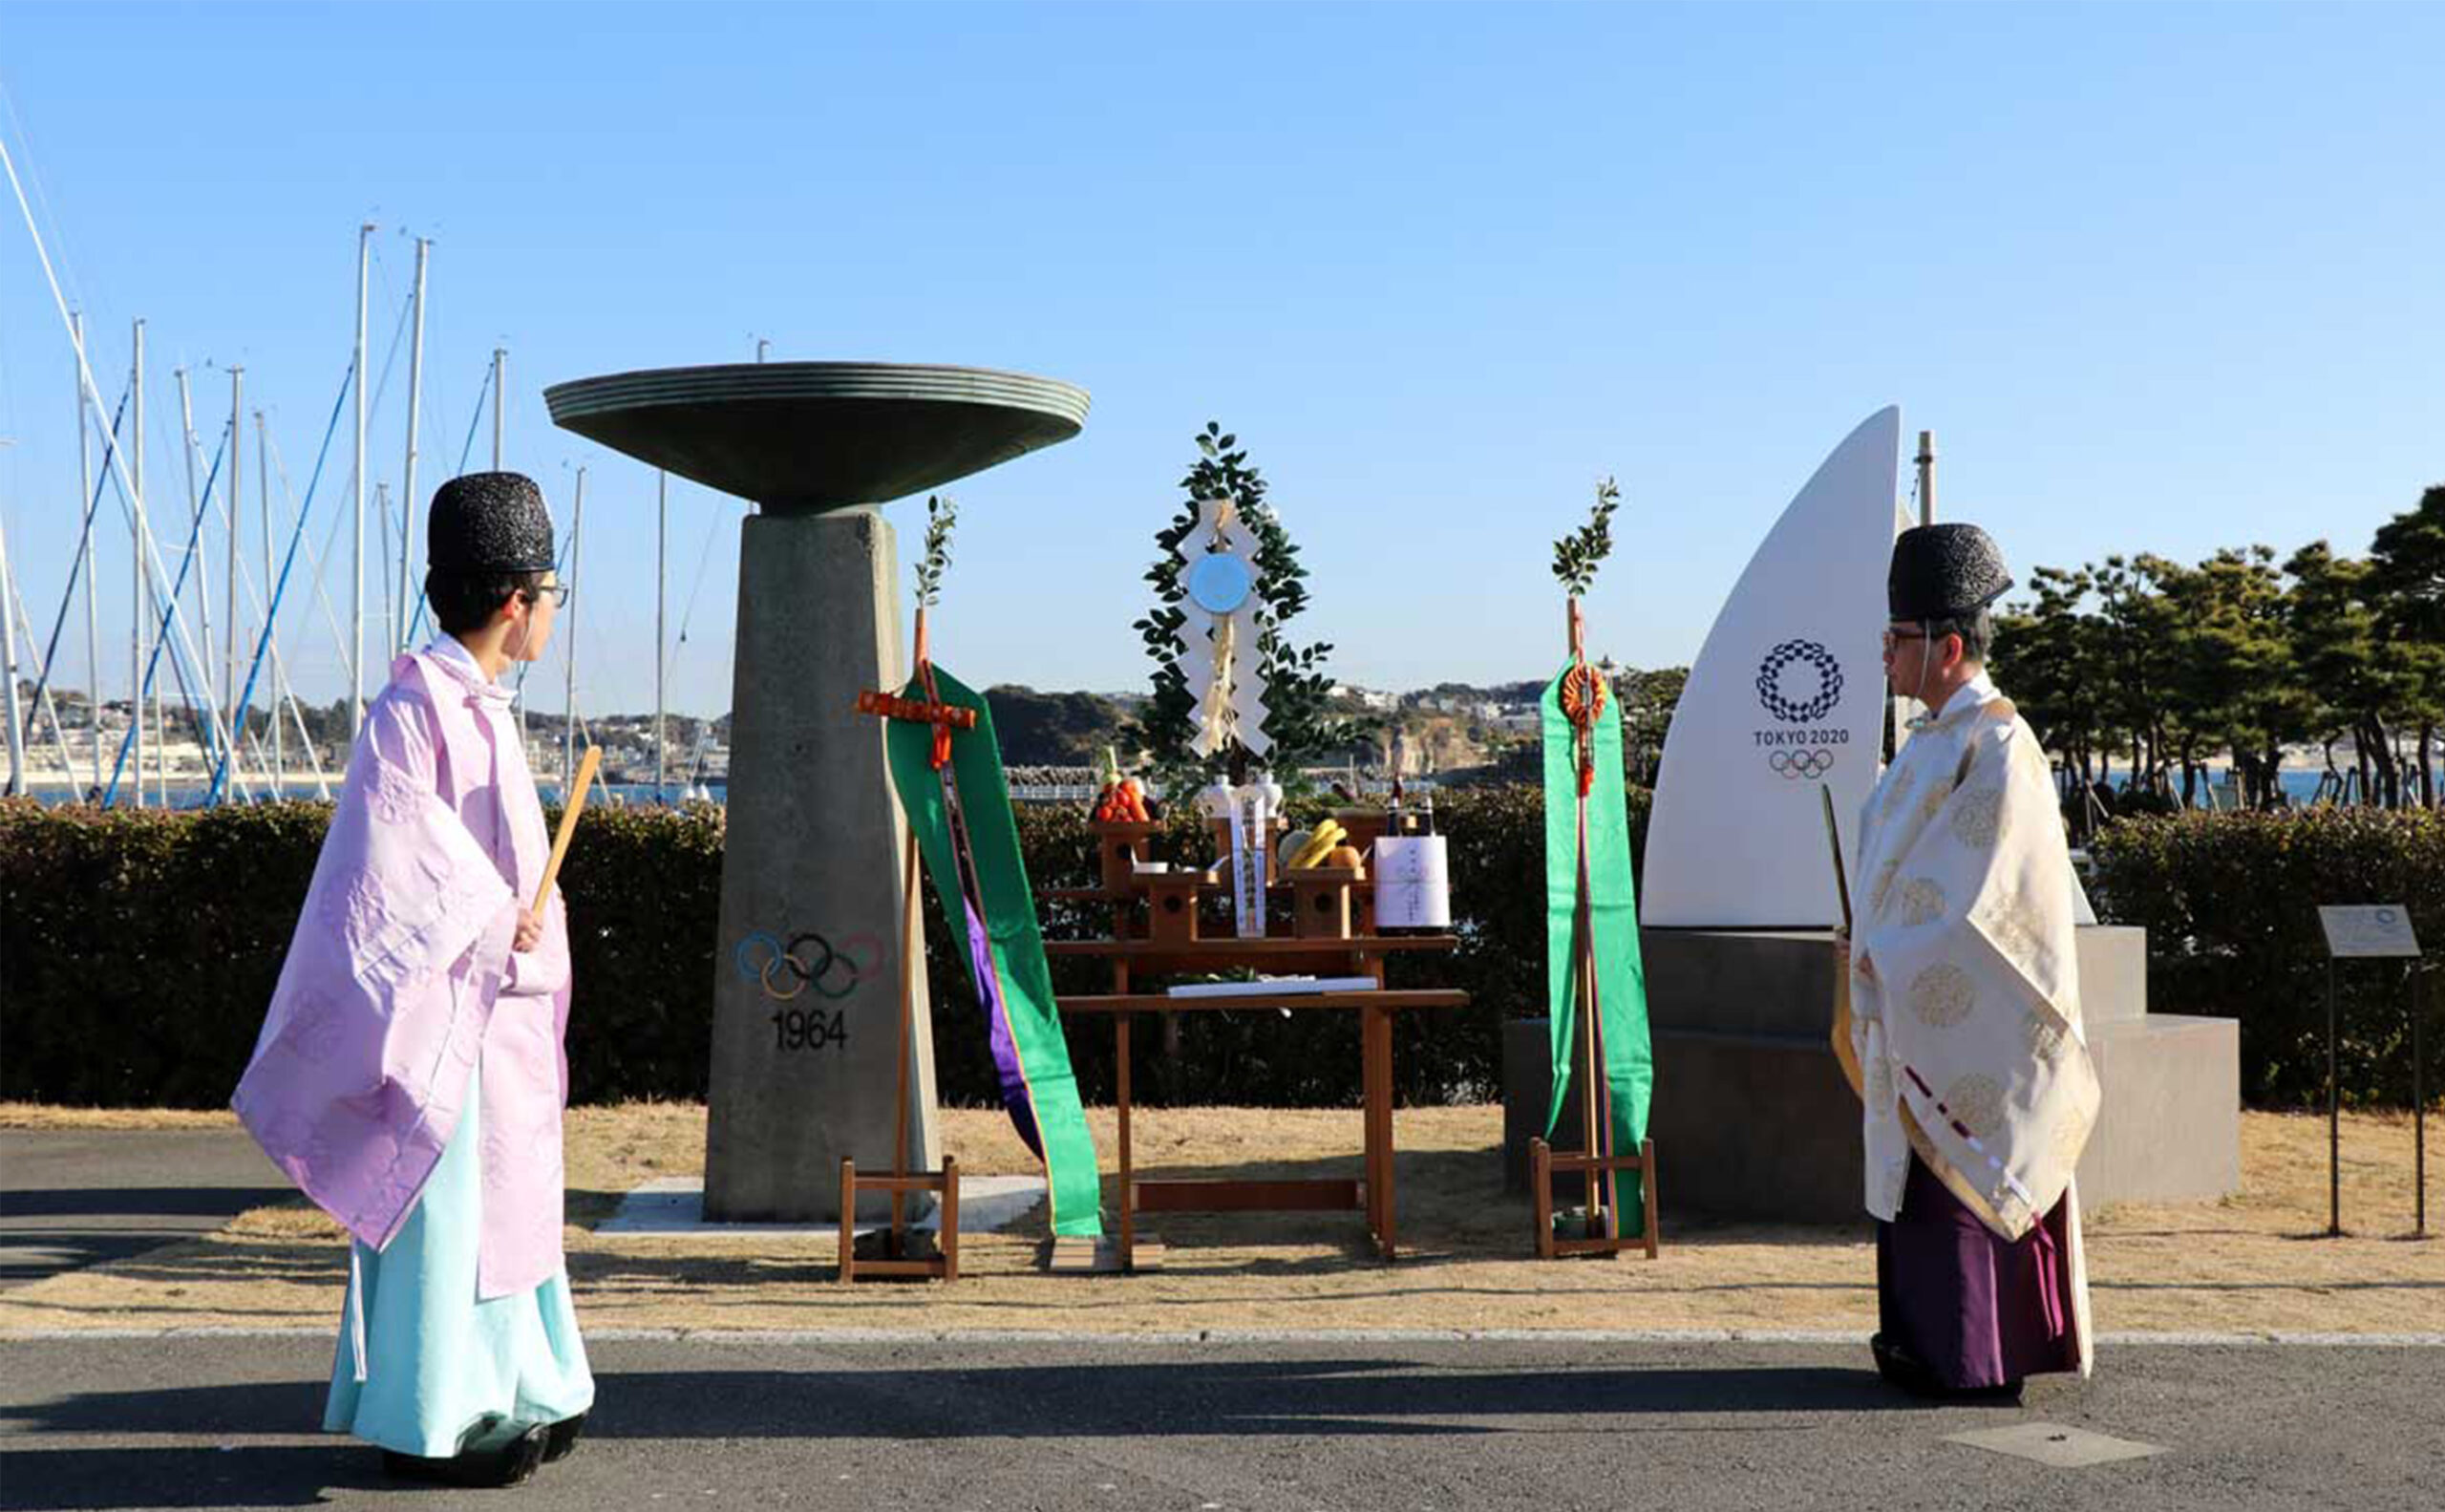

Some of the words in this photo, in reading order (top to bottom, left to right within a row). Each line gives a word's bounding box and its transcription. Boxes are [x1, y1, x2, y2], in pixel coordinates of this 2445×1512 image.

[1754, 730, 1807, 746] TOKYO
[1810, 729, 1849, 744] 2020
[772, 1010, 848, 1050] 1964
